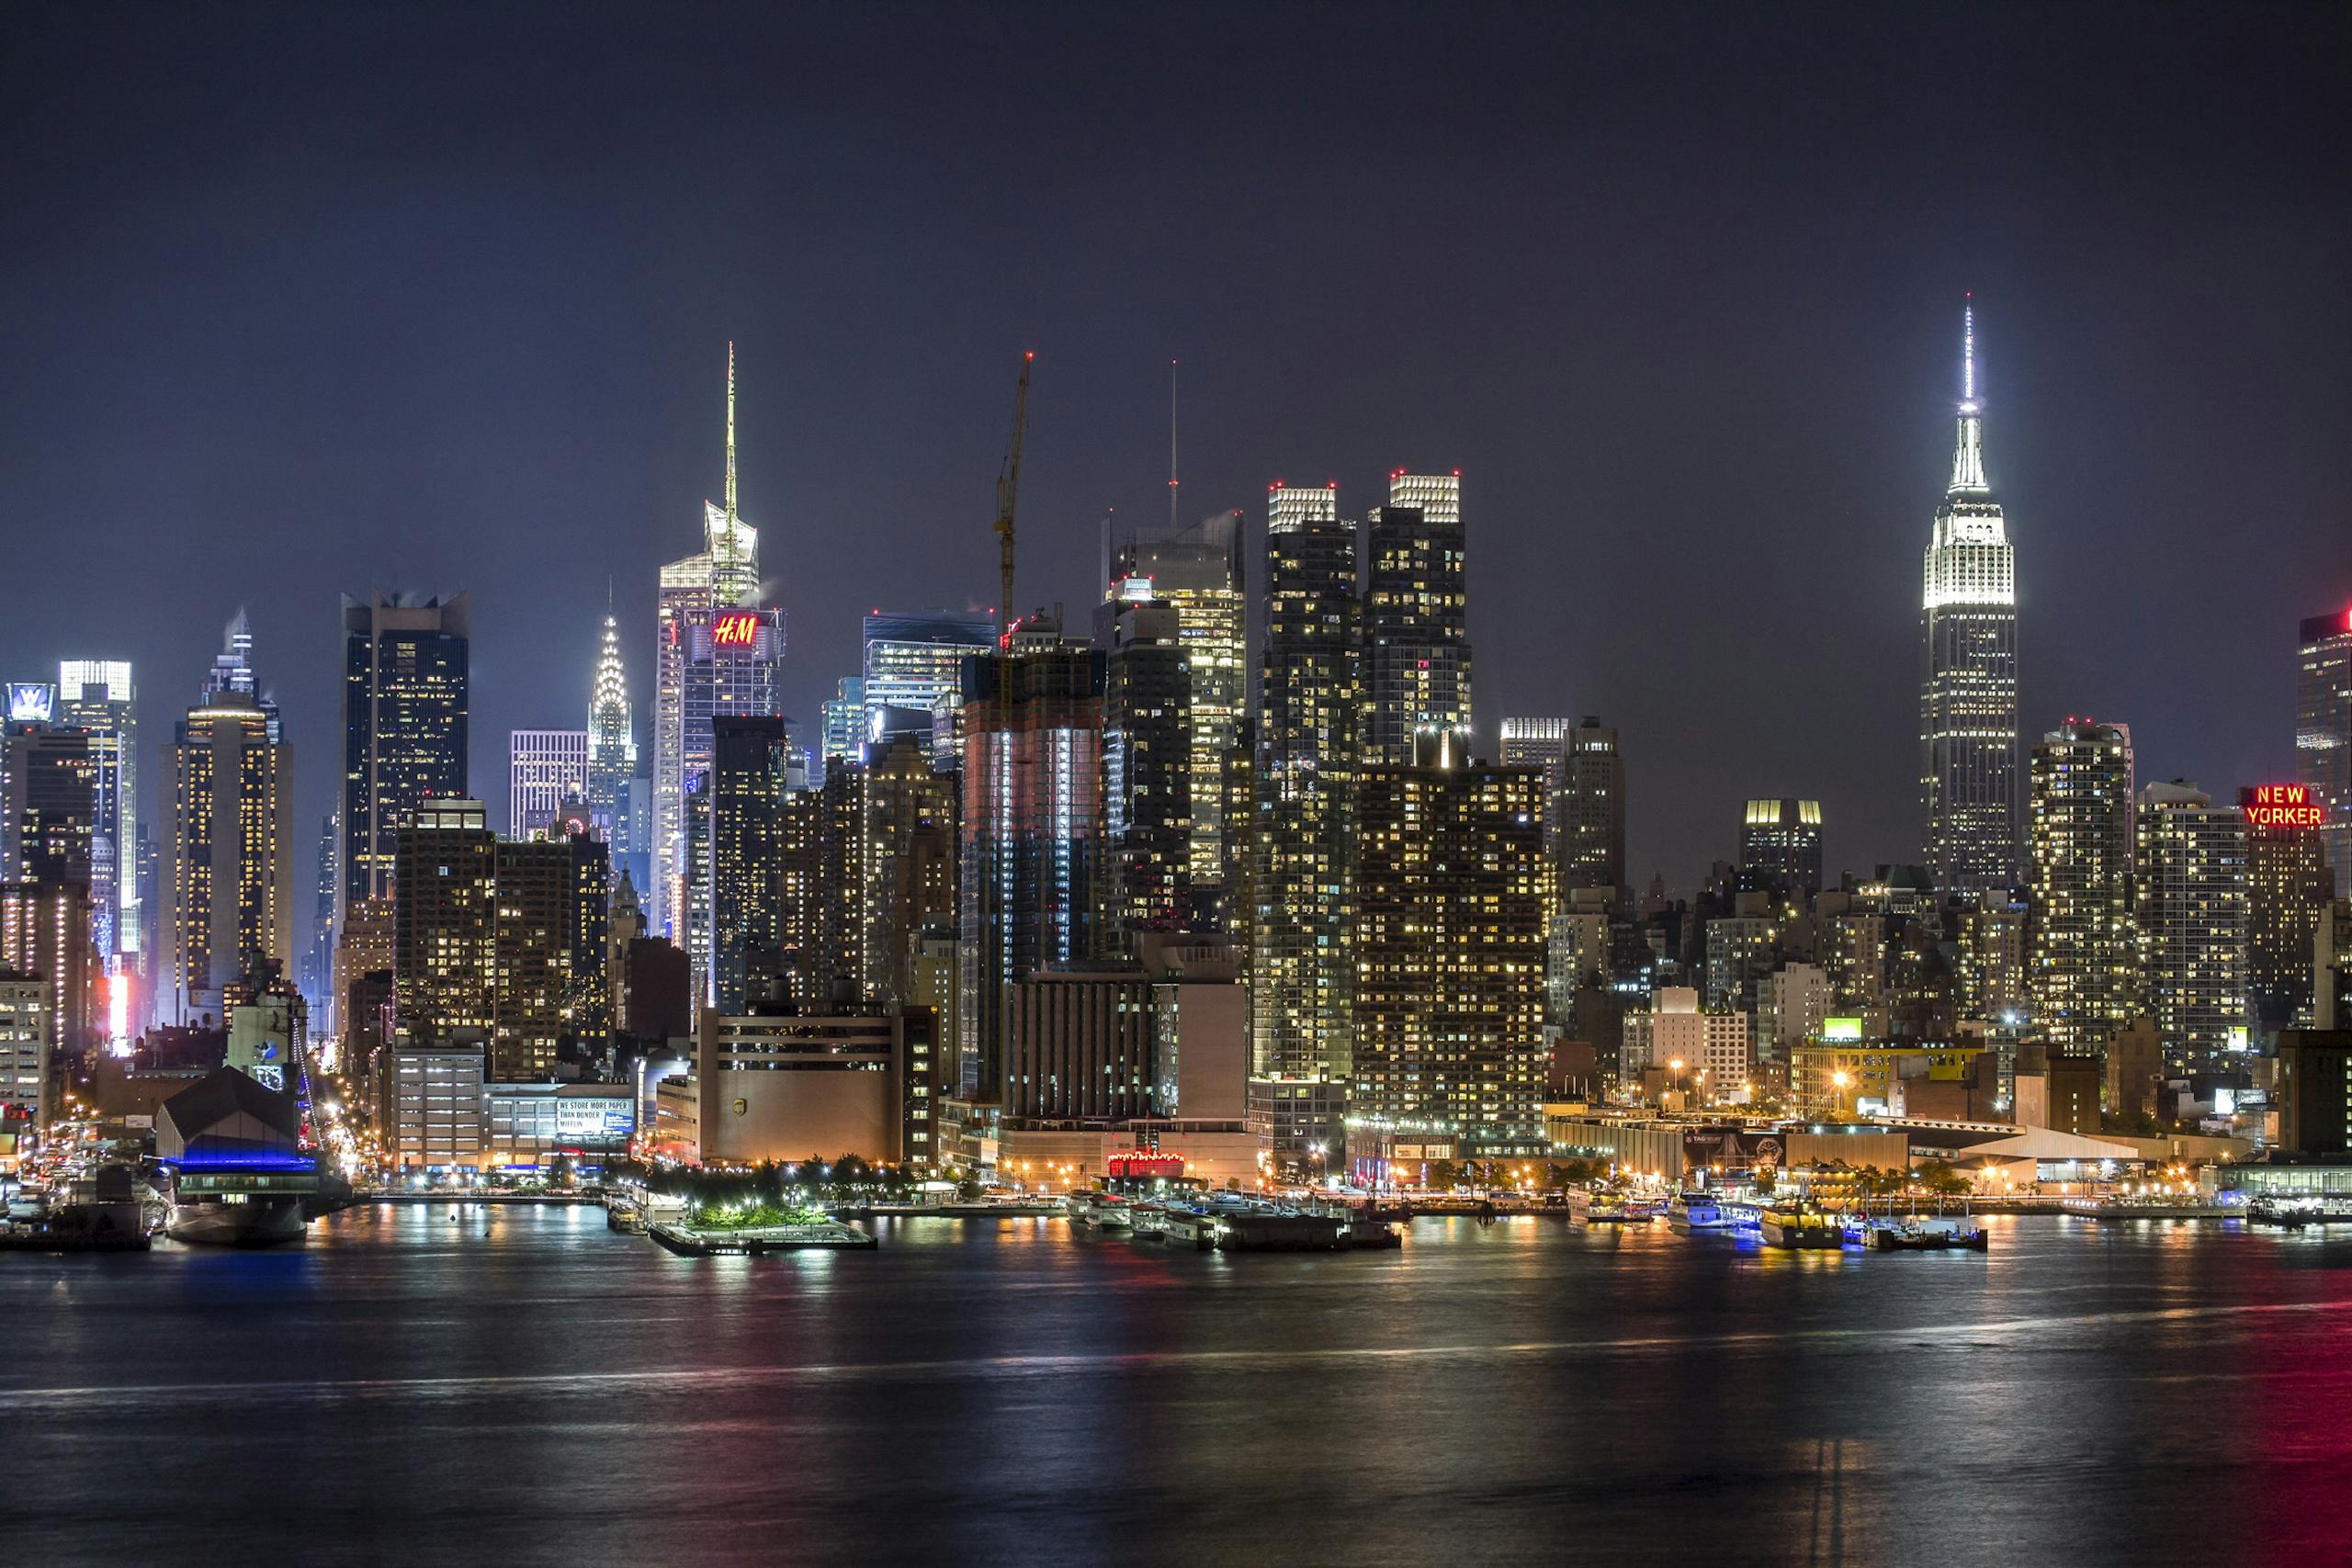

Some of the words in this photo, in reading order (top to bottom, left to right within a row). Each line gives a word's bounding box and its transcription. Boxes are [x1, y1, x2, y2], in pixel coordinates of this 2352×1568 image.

[715, 616, 756, 645] H&M
[2257, 786, 2304, 804] NEW
[2246, 807, 2322, 825] YORKER
[560, 1101, 569, 1110] WE
[571, 1101, 589, 1110] STORE
[590, 1101, 606, 1110] MORE
[608, 1101, 628, 1110] PAPER
[560, 1111, 575, 1119] THAN
[577, 1111, 600, 1119] DUNDER
